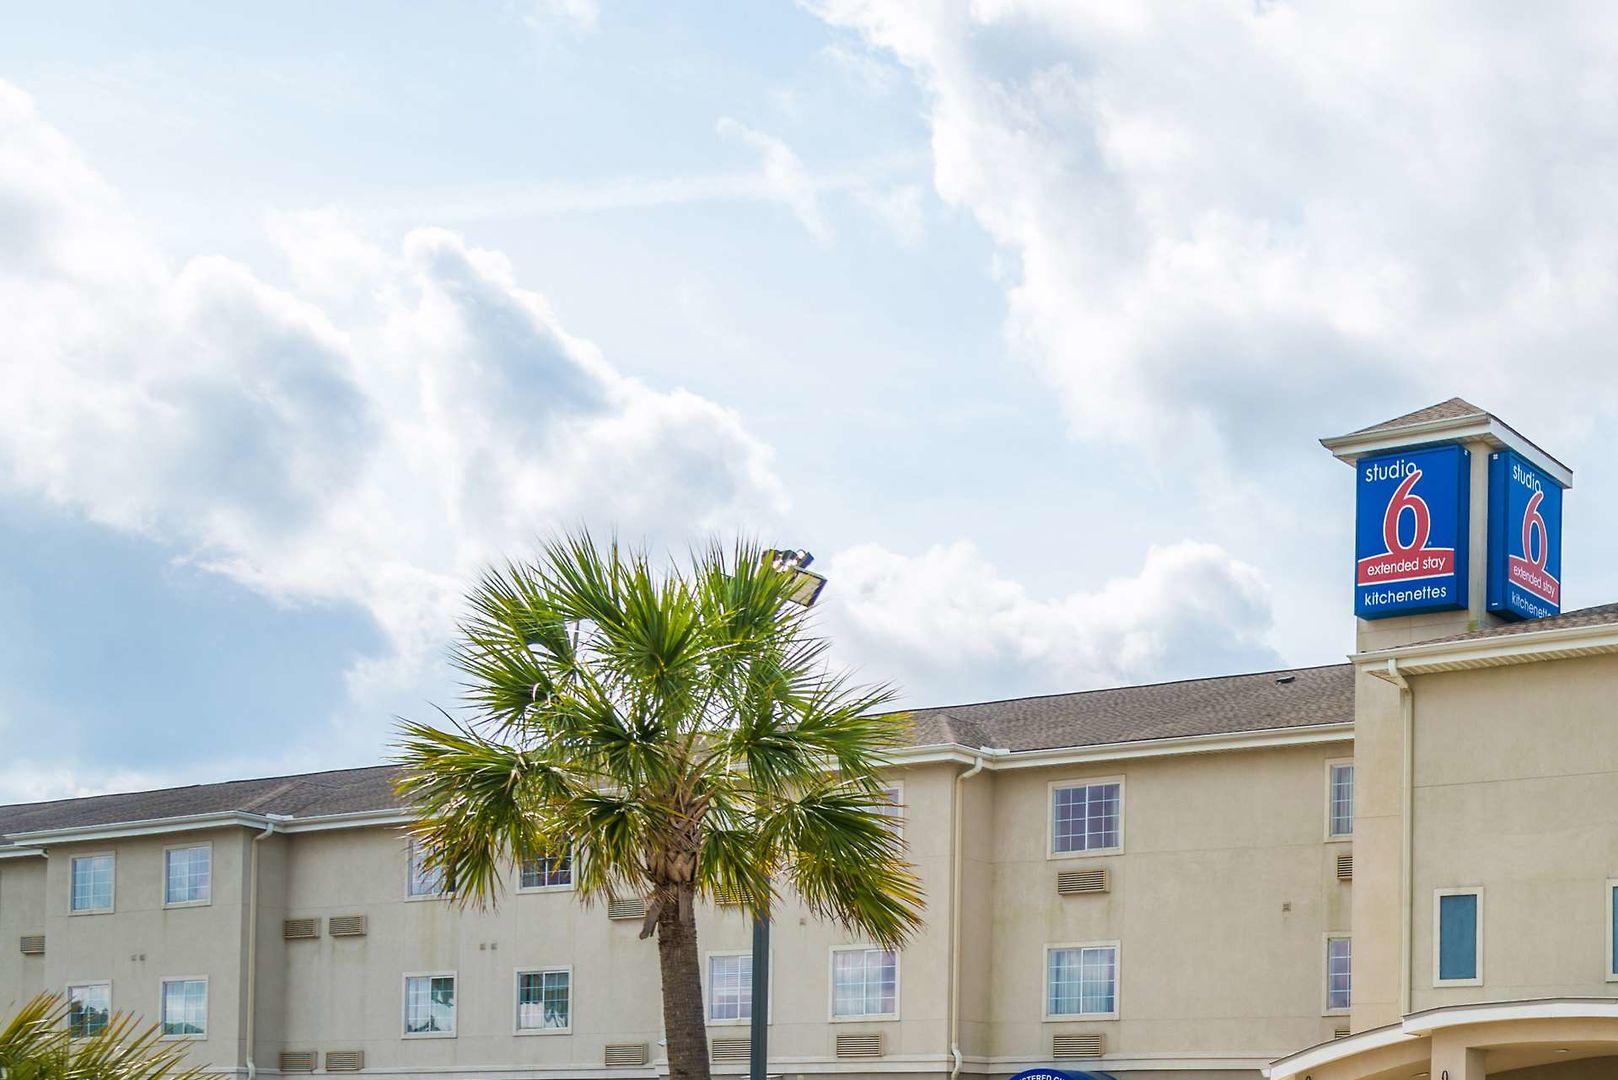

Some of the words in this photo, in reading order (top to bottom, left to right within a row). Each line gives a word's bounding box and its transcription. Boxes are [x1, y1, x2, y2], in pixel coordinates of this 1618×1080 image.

[1365, 459, 1417, 482] studio
[1512, 464, 1542, 491] studio
[1383, 469, 1431, 555] 6
[1522, 490, 1548, 571] 6
[1367, 557, 1419, 576] extended
[1422, 556, 1446, 571] stay
[1513, 565, 1542, 589] extended
[1542, 580, 1556, 598] stay
[1364, 585, 1447, 606] kitchenettes
